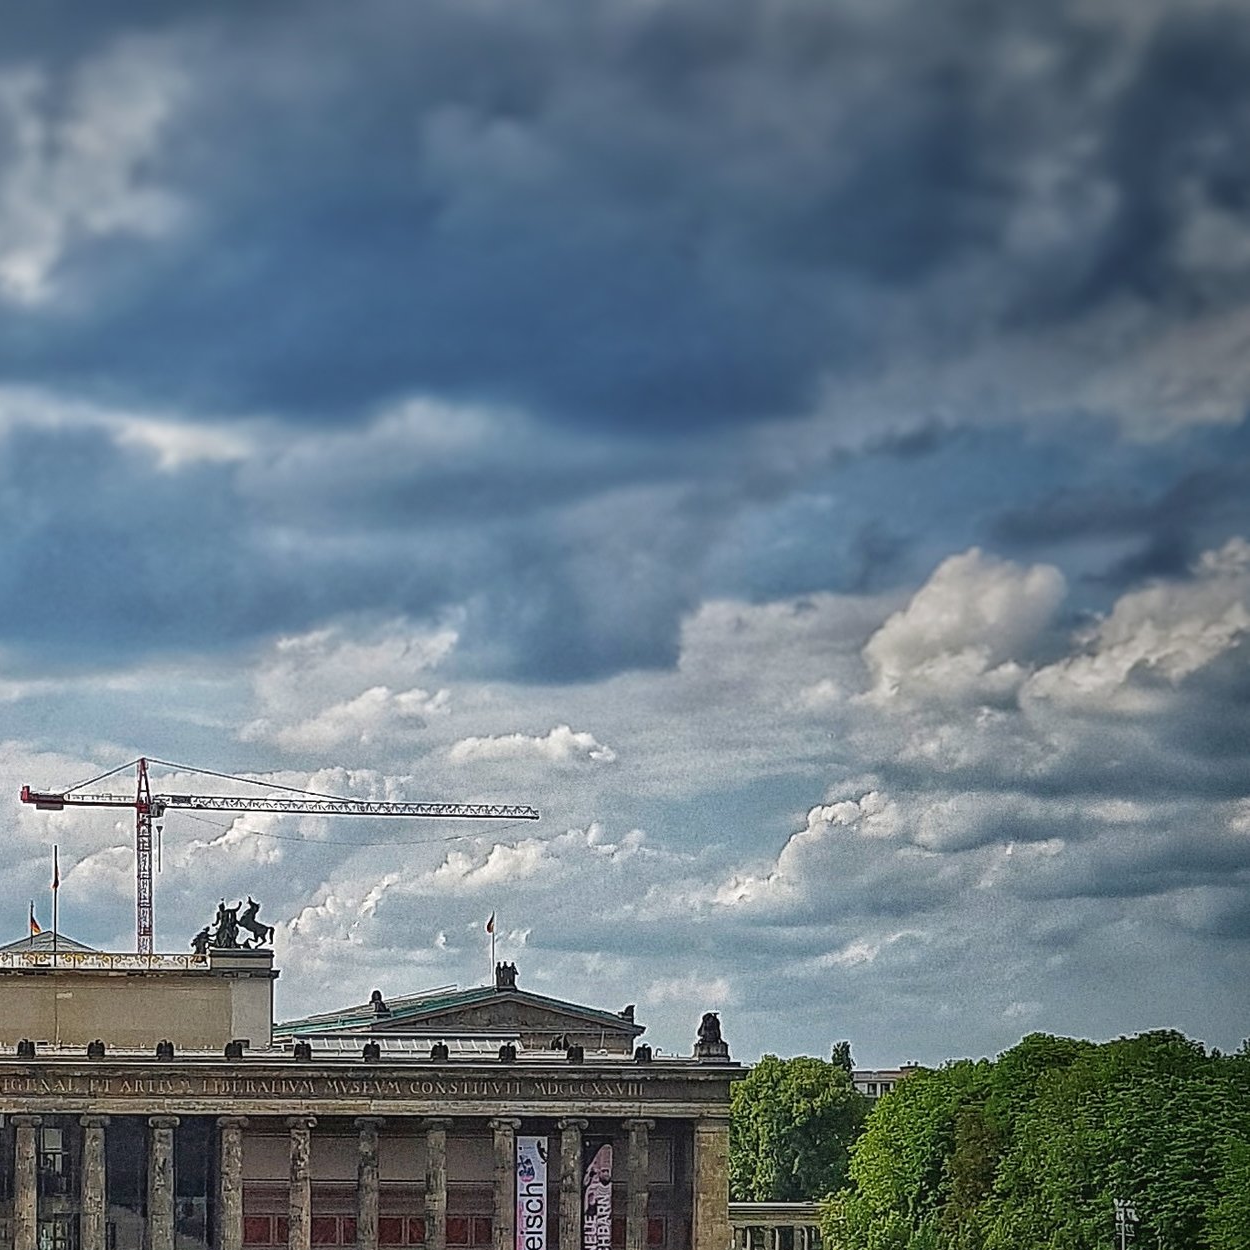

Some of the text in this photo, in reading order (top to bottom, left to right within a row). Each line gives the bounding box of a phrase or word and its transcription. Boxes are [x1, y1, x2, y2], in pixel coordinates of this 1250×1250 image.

[88, 1079, 113, 1092] ET
[202, 1079, 315, 1093] LIBERALIVM
[325, 1080, 401, 1094] MVSEVM
[410, 1081, 522, 1095] CONSTITVIT
[531, 1081, 644, 1096] MDCCCXXVIII
